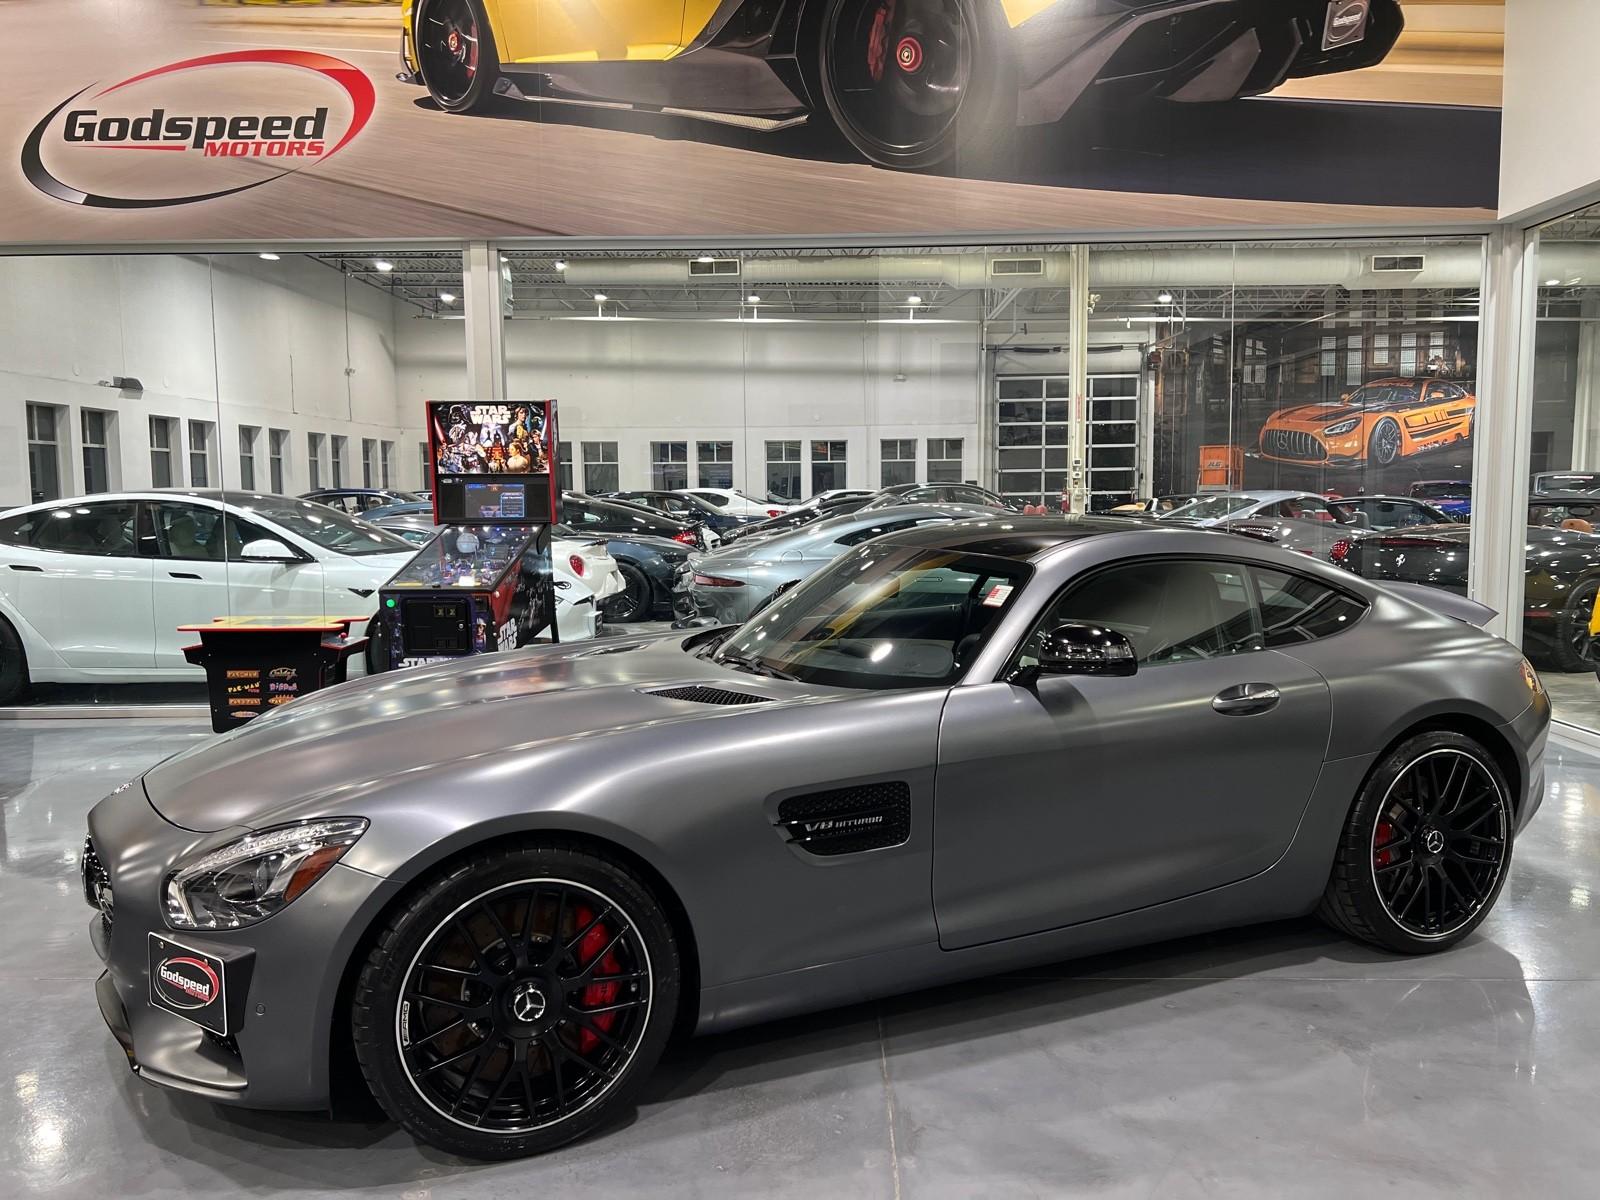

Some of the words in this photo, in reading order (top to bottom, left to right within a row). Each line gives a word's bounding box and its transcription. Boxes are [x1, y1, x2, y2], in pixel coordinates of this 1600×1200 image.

[63, 107, 329, 149] Godspeed
[203, 140, 325, 157] MOTORS
[470, 405, 511, 415] STAR
[470, 414, 511, 425] WARS
[497, 617, 518, 642] STAR
[227, 682, 260, 693] PAC-MAN
[805, 820, 834, 832] V8
[160, 965, 210, 996] Godspeed
